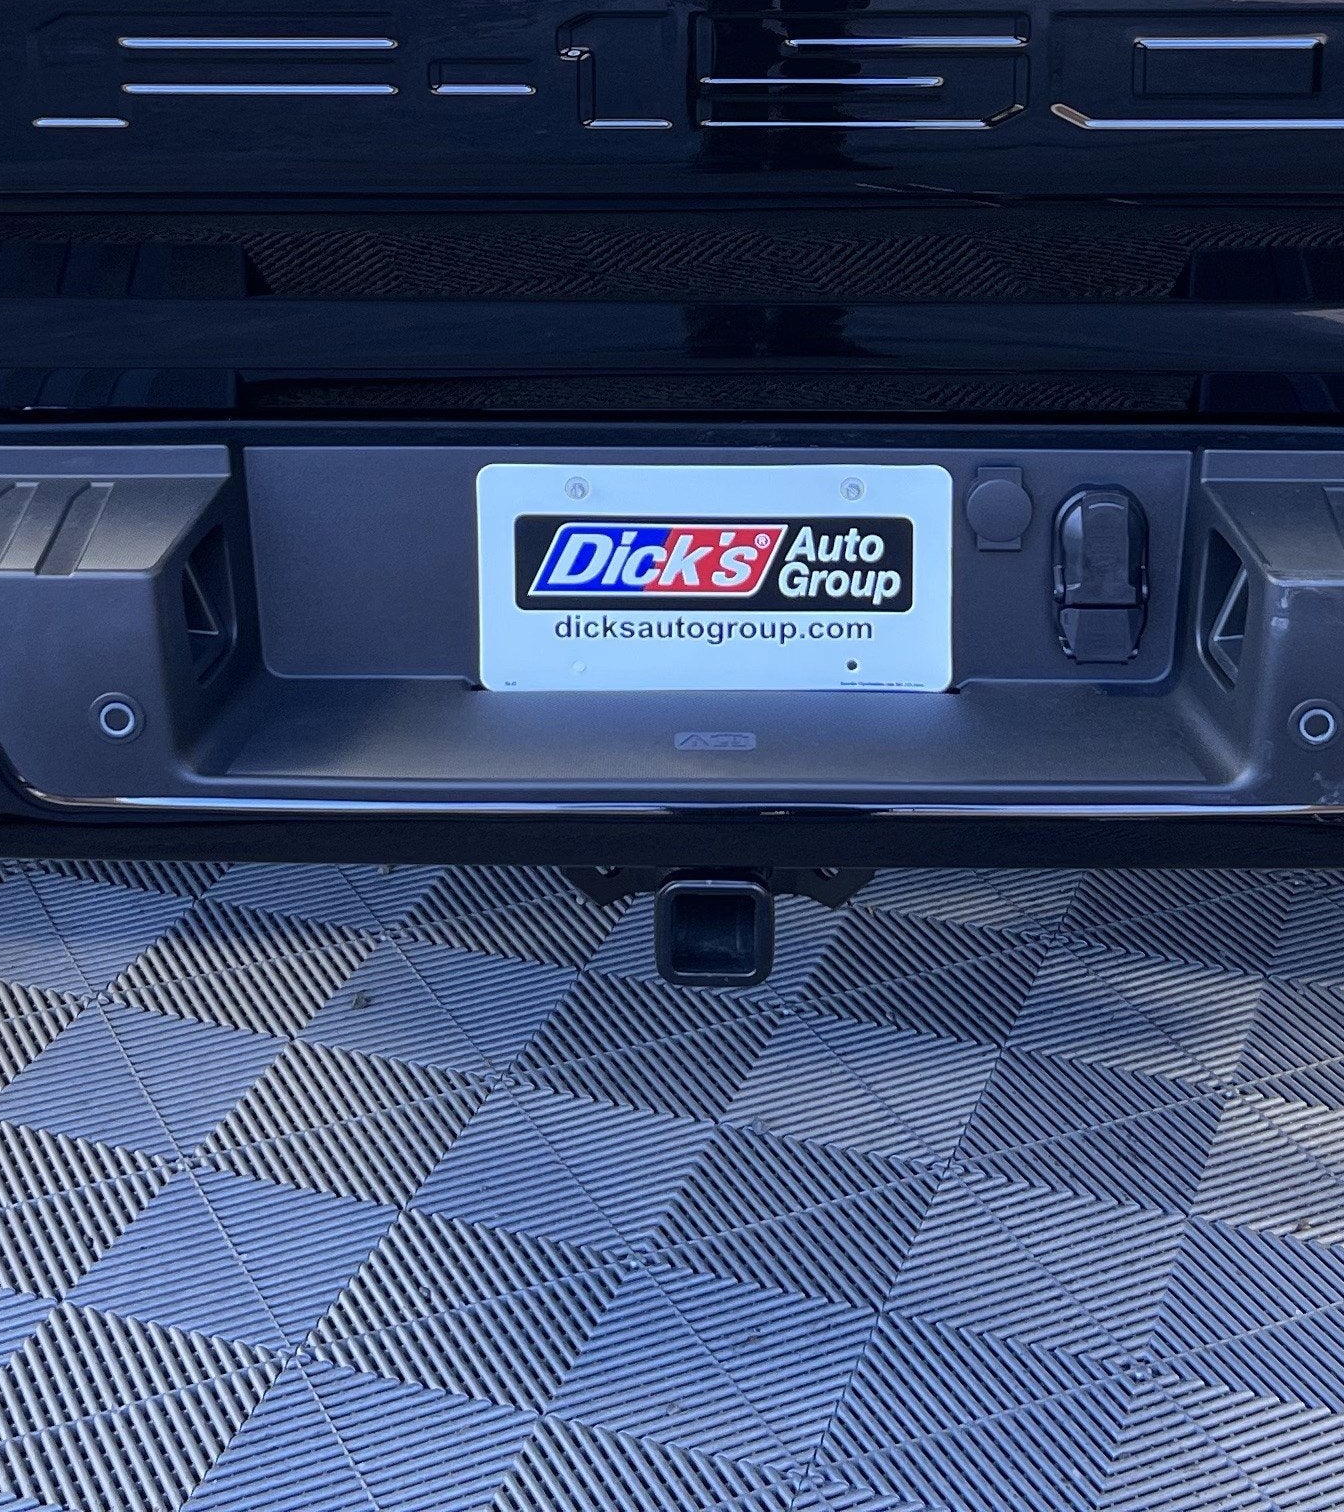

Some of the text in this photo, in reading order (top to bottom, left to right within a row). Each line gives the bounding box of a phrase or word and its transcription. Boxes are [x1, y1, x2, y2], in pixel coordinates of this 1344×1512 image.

[783, 525, 886, 564] Auto
[777, 562, 903, 606] Group
[554, 614, 874, 645] dicksautogroup.com
